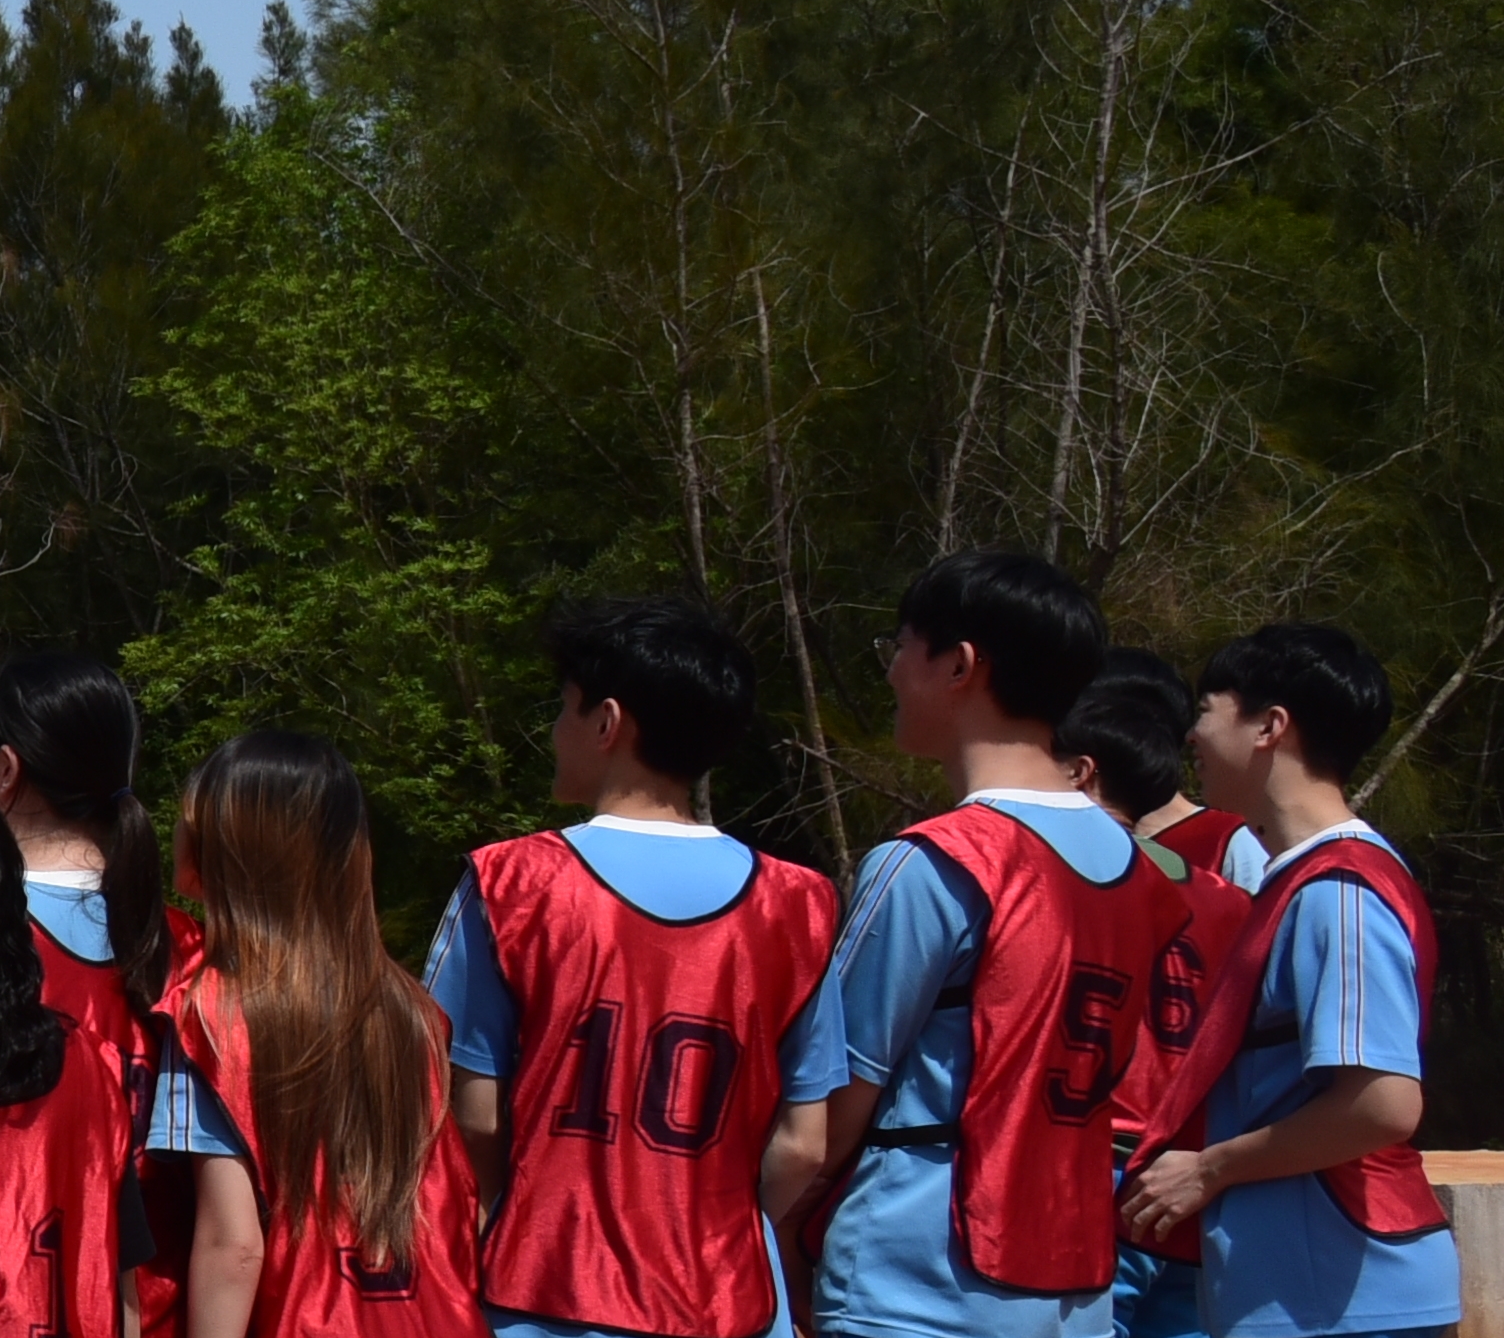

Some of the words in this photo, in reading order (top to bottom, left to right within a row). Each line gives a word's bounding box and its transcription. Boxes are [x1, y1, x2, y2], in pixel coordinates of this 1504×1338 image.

[1044, 961, 1133, 1126] 5
[1145, 936, 1206, 1056] 6
[549, 999, 745, 1159] 10
